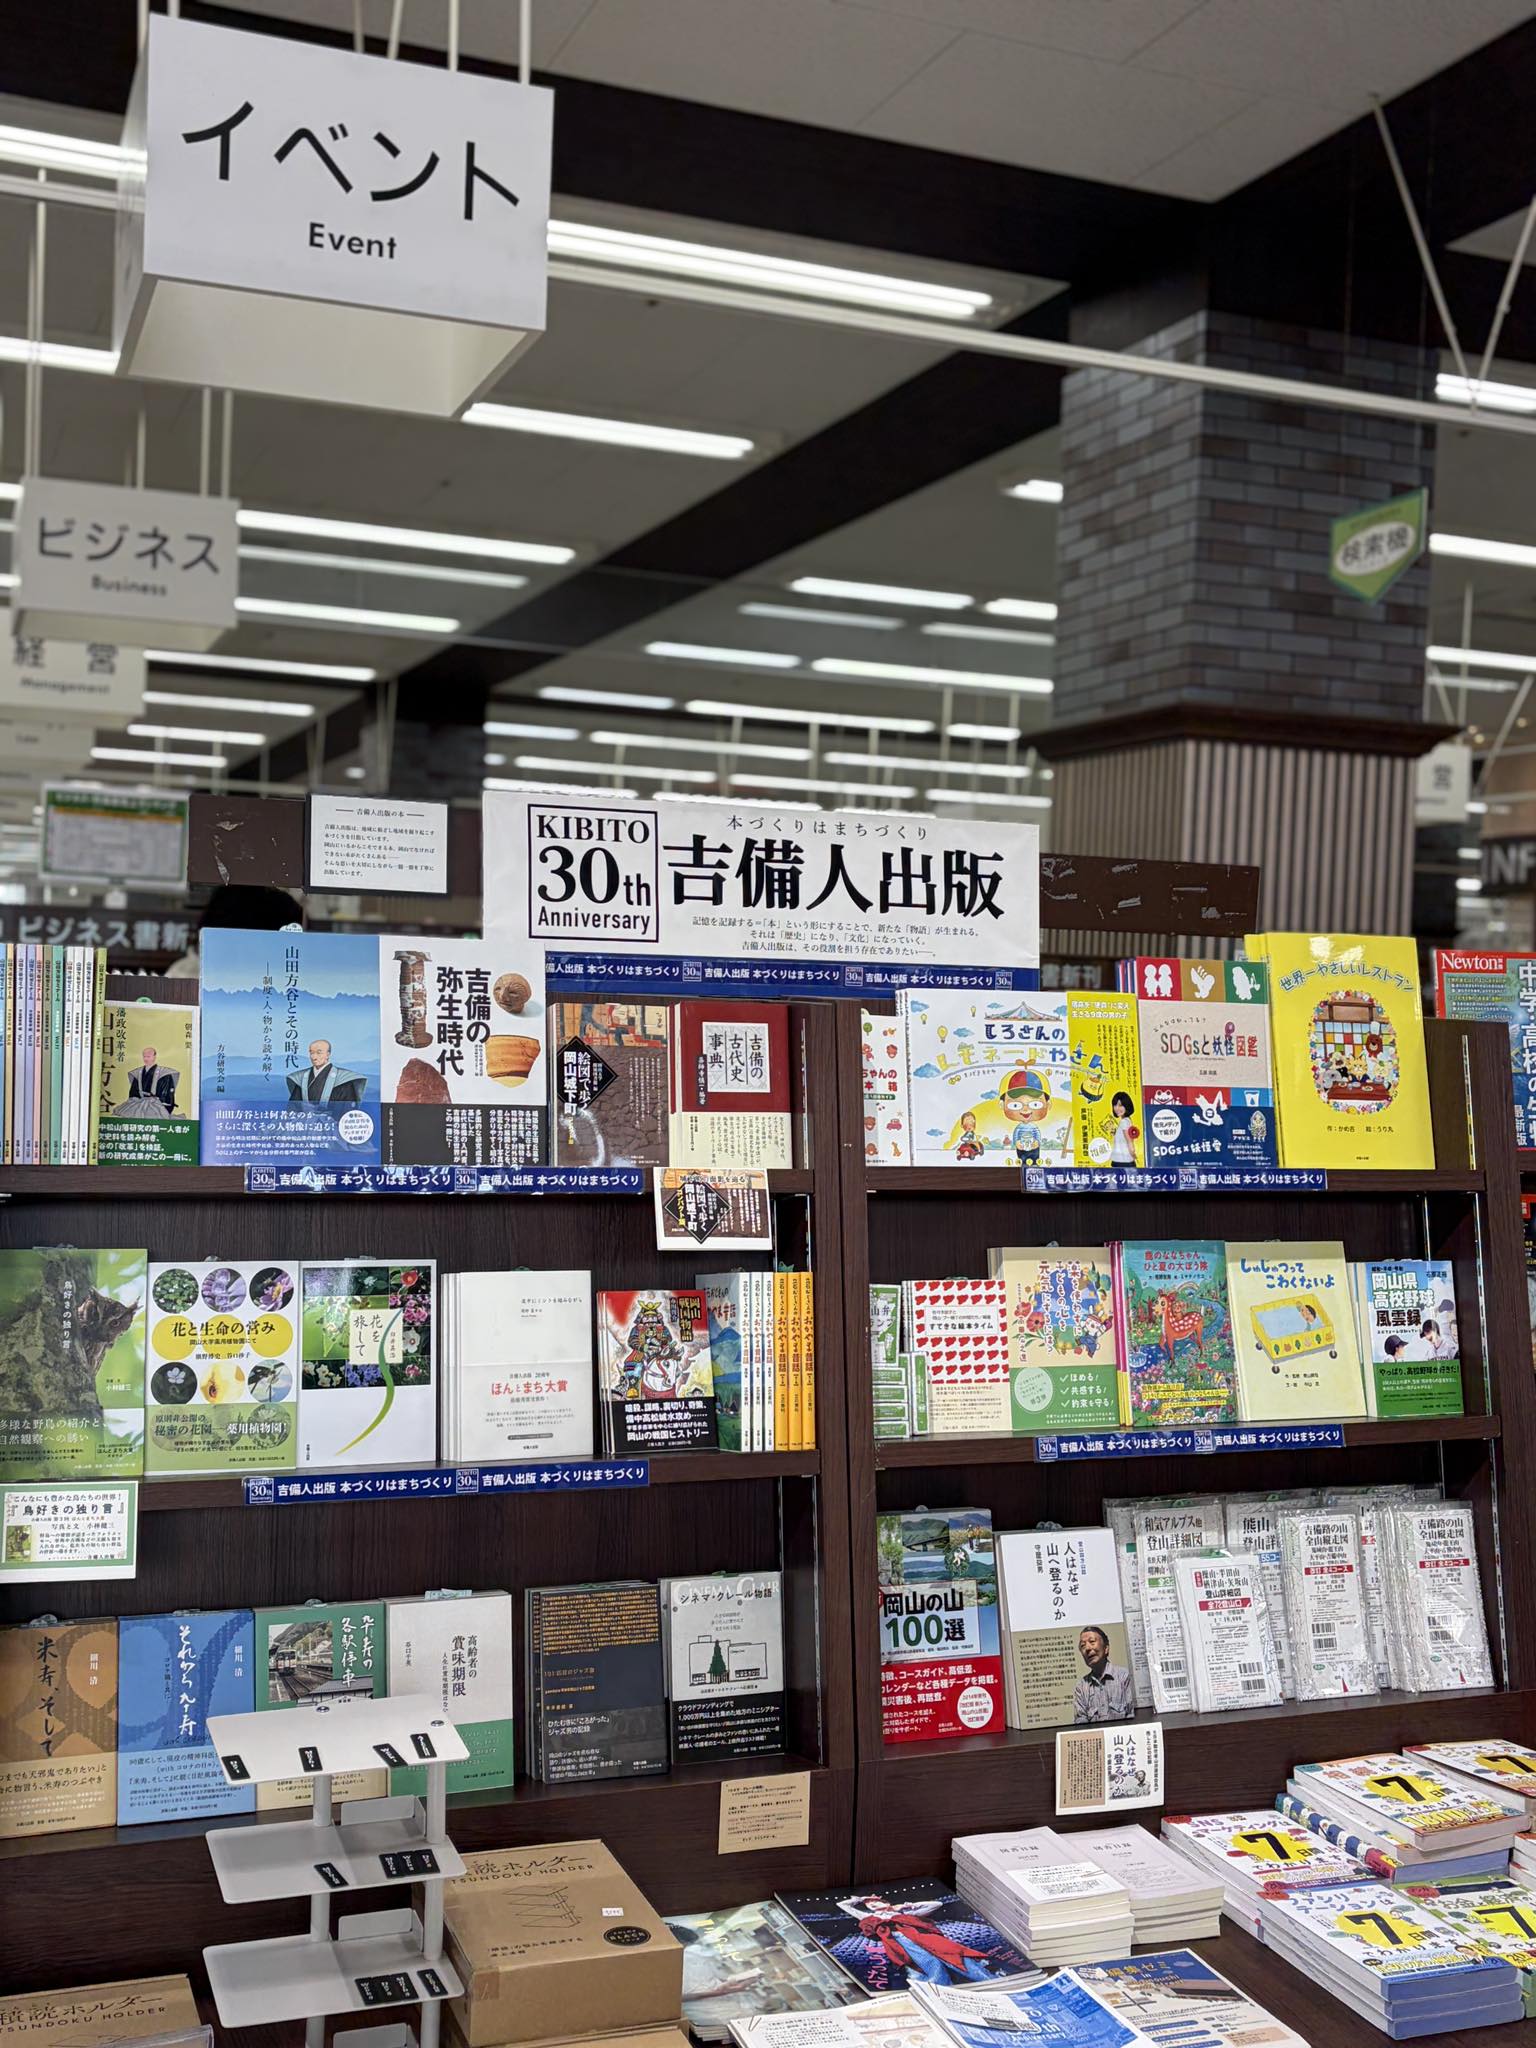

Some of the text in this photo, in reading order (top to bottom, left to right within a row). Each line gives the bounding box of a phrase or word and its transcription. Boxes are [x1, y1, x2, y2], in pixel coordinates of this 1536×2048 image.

[181, 101, 520, 221] イベント
[308, 222, 398, 261] Event
[38, 516, 220, 575] ビジネス
[92, 574, 168, 598] Business
[20, 678, 109, 694] Management
[356, 808, 405, 818] 吉備人出版の本
[727, 814, 928, 840] 本づくりはまちづくり
[537, 814, 650, 843] KIBITO
[538, 846, 650, 906] 30th
[662, 834, 1005, 919] 吉備人出版
[538, 906, 650, 934] Anniversary
[587, 965, 993, 986] 本づくりはまちづくり 吉備人出版 本づくりはまちづくり 吉備人出版 本づくりはまちづくり
[1441, 952, 1498, 972] Newton
[1279, 962, 1415, 993] 世界一やさしいレストラン
[285, 946, 300, 1069] 山田方谷とその時代
[465, 968, 491, 1044] 吉備の
[116, 1008, 126, 1062] 藩政改革者
[437, 967, 464, 1076] 弥生時代
[709, 1033, 724, 1068] 事典
[729, 1035, 745, 1083] 古代史
[749, 1034, 764, 1079] 吉備の
[563, 1052, 576, 1115] 岡山城下町
[577, 1052, 591, 1111] 絵図で歩く
[1514, 1105, 1527, 1146] 最新版
[340, 1173, 451, 1186] 本づくりはまちづくり
[479, 1174, 533, 1186] 吉備人出版
[537, 1174, 639, 1186] 本づくりはまちづくり
[1047, 1173, 1323, 1186] 吉備人出版 本づくりはまちづくり 吉備人出版 本づくりはまちづくり
[685, 1184, 697, 1231] 岡山城下町
[696, 1184, 707, 1232] 絵図で歩く
[1240, 1259, 1304, 1273] しゅじゅつって
[1266, 1275, 1335, 1289] こわくないよ
[1372, 1272, 1418, 1290] 岡山県
[1373, 1290, 1434, 1309] 高校野球
[63, 1280, 73, 1349] 鳥好きの独り言
[1376, 1310, 1421, 1326] 風雲録
[172, 1321, 275, 1337] 花と生命の営み
[353, 1316, 368, 1357] 旅して
[369, 1316, 383, 1343] 花を
[491, 1380, 568, 1395] ほんとまち大賞
[1071, 1387, 1107, 1395] 共感する！
[627, 1430, 709, 1441] 岡山の戦国ヒストリー
[1059, 1431, 1341, 1452] 吉備人出版 本づくりはまちづくり 吉備人出版 本づくりはまちづくり
[278, 1468, 645, 1497] 吉備人出版 本づくりはまちづくり 吉備人出版 本づくりはまちづくり
[23, 1503, 113, 1515] 鳥好きの独り言
[1145, 1516, 1202, 1533] 和気アルプス他
[1243, 1517, 1270, 1533] 熊山
[1305, 1523, 1348, 1536] 吉備路の山
[1418, 1518, 1463, 1530] 吉備路の山
[1420, 1529, 1465, 1540] 全山縦走図
[1147, 1532, 1203, 1551] 登山詳細図
[1305, 1534, 1349, 1547] 全山縦走図
[1047, 1543, 1066, 1621] 山へ登るのか
[1064, 1542, 1079, 1596] 人はなぜ
[680, 1588, 773, 1604] シネマ・クレール物語
[883, 1588, 964, 1617] 岡山の山
[885, 1614, 966, 1649] 100選
[177, 1626, 197, 1688] それから
[234, 1645, 243, 1677] 細川 清
[341, 1618, 357, 1688] 各駅停車
[452, 1636, 466, 1697] 賞味期限
[467, 1635, 478, 1678] 高齢者の
[89, 1653, 98, 1685] 細川 清
[37, 1636, 59, 1757] 米寿、そして
[1113, 1734, 1125, 1798] 山へ登るのか
[1126, 1734, 1137, 1778] 人はなぜ
[1483, 1755, 1535, 1775] 7
[1374, 1776, 1423, 1801] 7
[1189, 1818, 1221, 1828] SNS
[1240, 1832, 1291, 1860] 7
[451, 1864, 594, 1884] TSUNDOKU HOLDER
[1289, 1892, 1348, 1907] ファシリ
[1345, 1911, 1401, 1945] 7
[1412, 1930, 1440, 1941] 日間
[1477, 1906, 1536, 1939] 7
[103, 2007, 165, 2020] HOLDER
